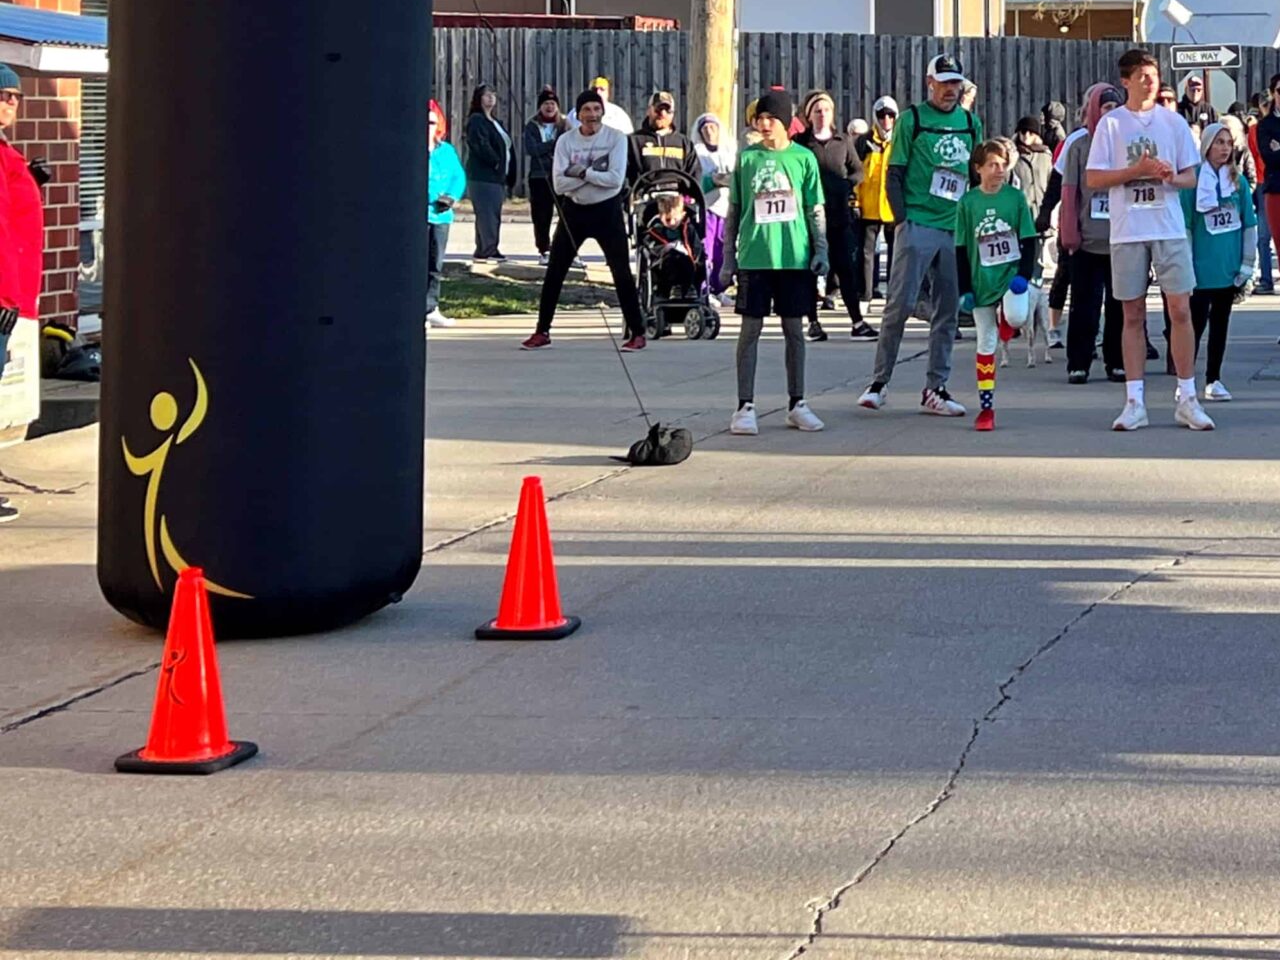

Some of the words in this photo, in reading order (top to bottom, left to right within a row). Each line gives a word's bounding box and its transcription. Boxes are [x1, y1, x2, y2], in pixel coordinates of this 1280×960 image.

[1179, 53, 1198, 62] ONE
[1200, 52, 1219, 61] WAY
[939, 176, 958, 193] 716
[1133, 187, 1156, 203] 718
[766, 199, 786, 215] 717
[1211, 211, 1233, 227] 732
[987, 240, 1011, 258] 719
